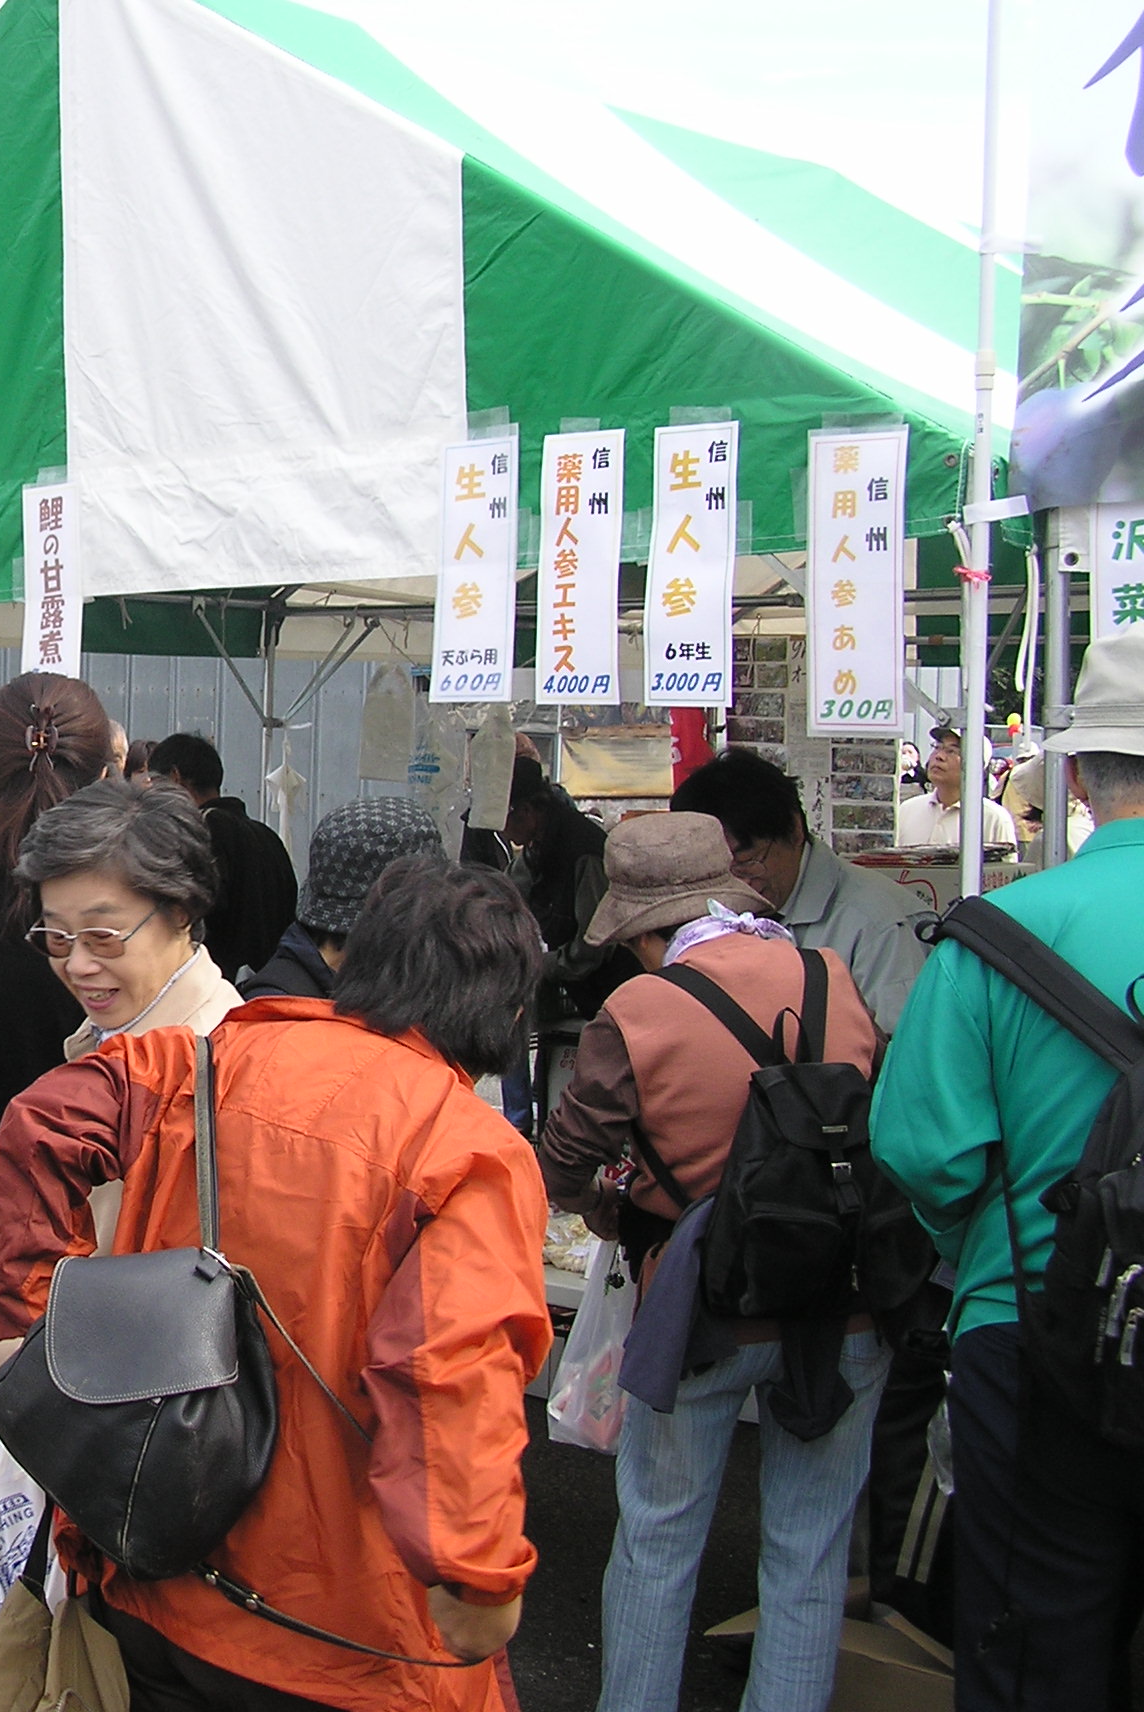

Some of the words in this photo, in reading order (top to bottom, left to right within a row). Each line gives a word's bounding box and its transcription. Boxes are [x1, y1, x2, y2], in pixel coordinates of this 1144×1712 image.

[489, 453, 509, 519] 信州
[589, 447, 611, 515] 信州
[706, 440, 728, 510] 信州
[452, 463, 487, 620] 生人参
[662, 450, 702, 618] 生人参
[865, 477, 889, 552] 信州
[39, 496, 65, 665] 鯉の甘露煮
[553, 453, 584, 673] 薬用人参エキス
[831, 446, 859, 696] 薬用人参あめ
[440, 673, 502, 692] 600円
[665, 642, 713, 661] 6年生
[819, 699, 893, 721] 300円
